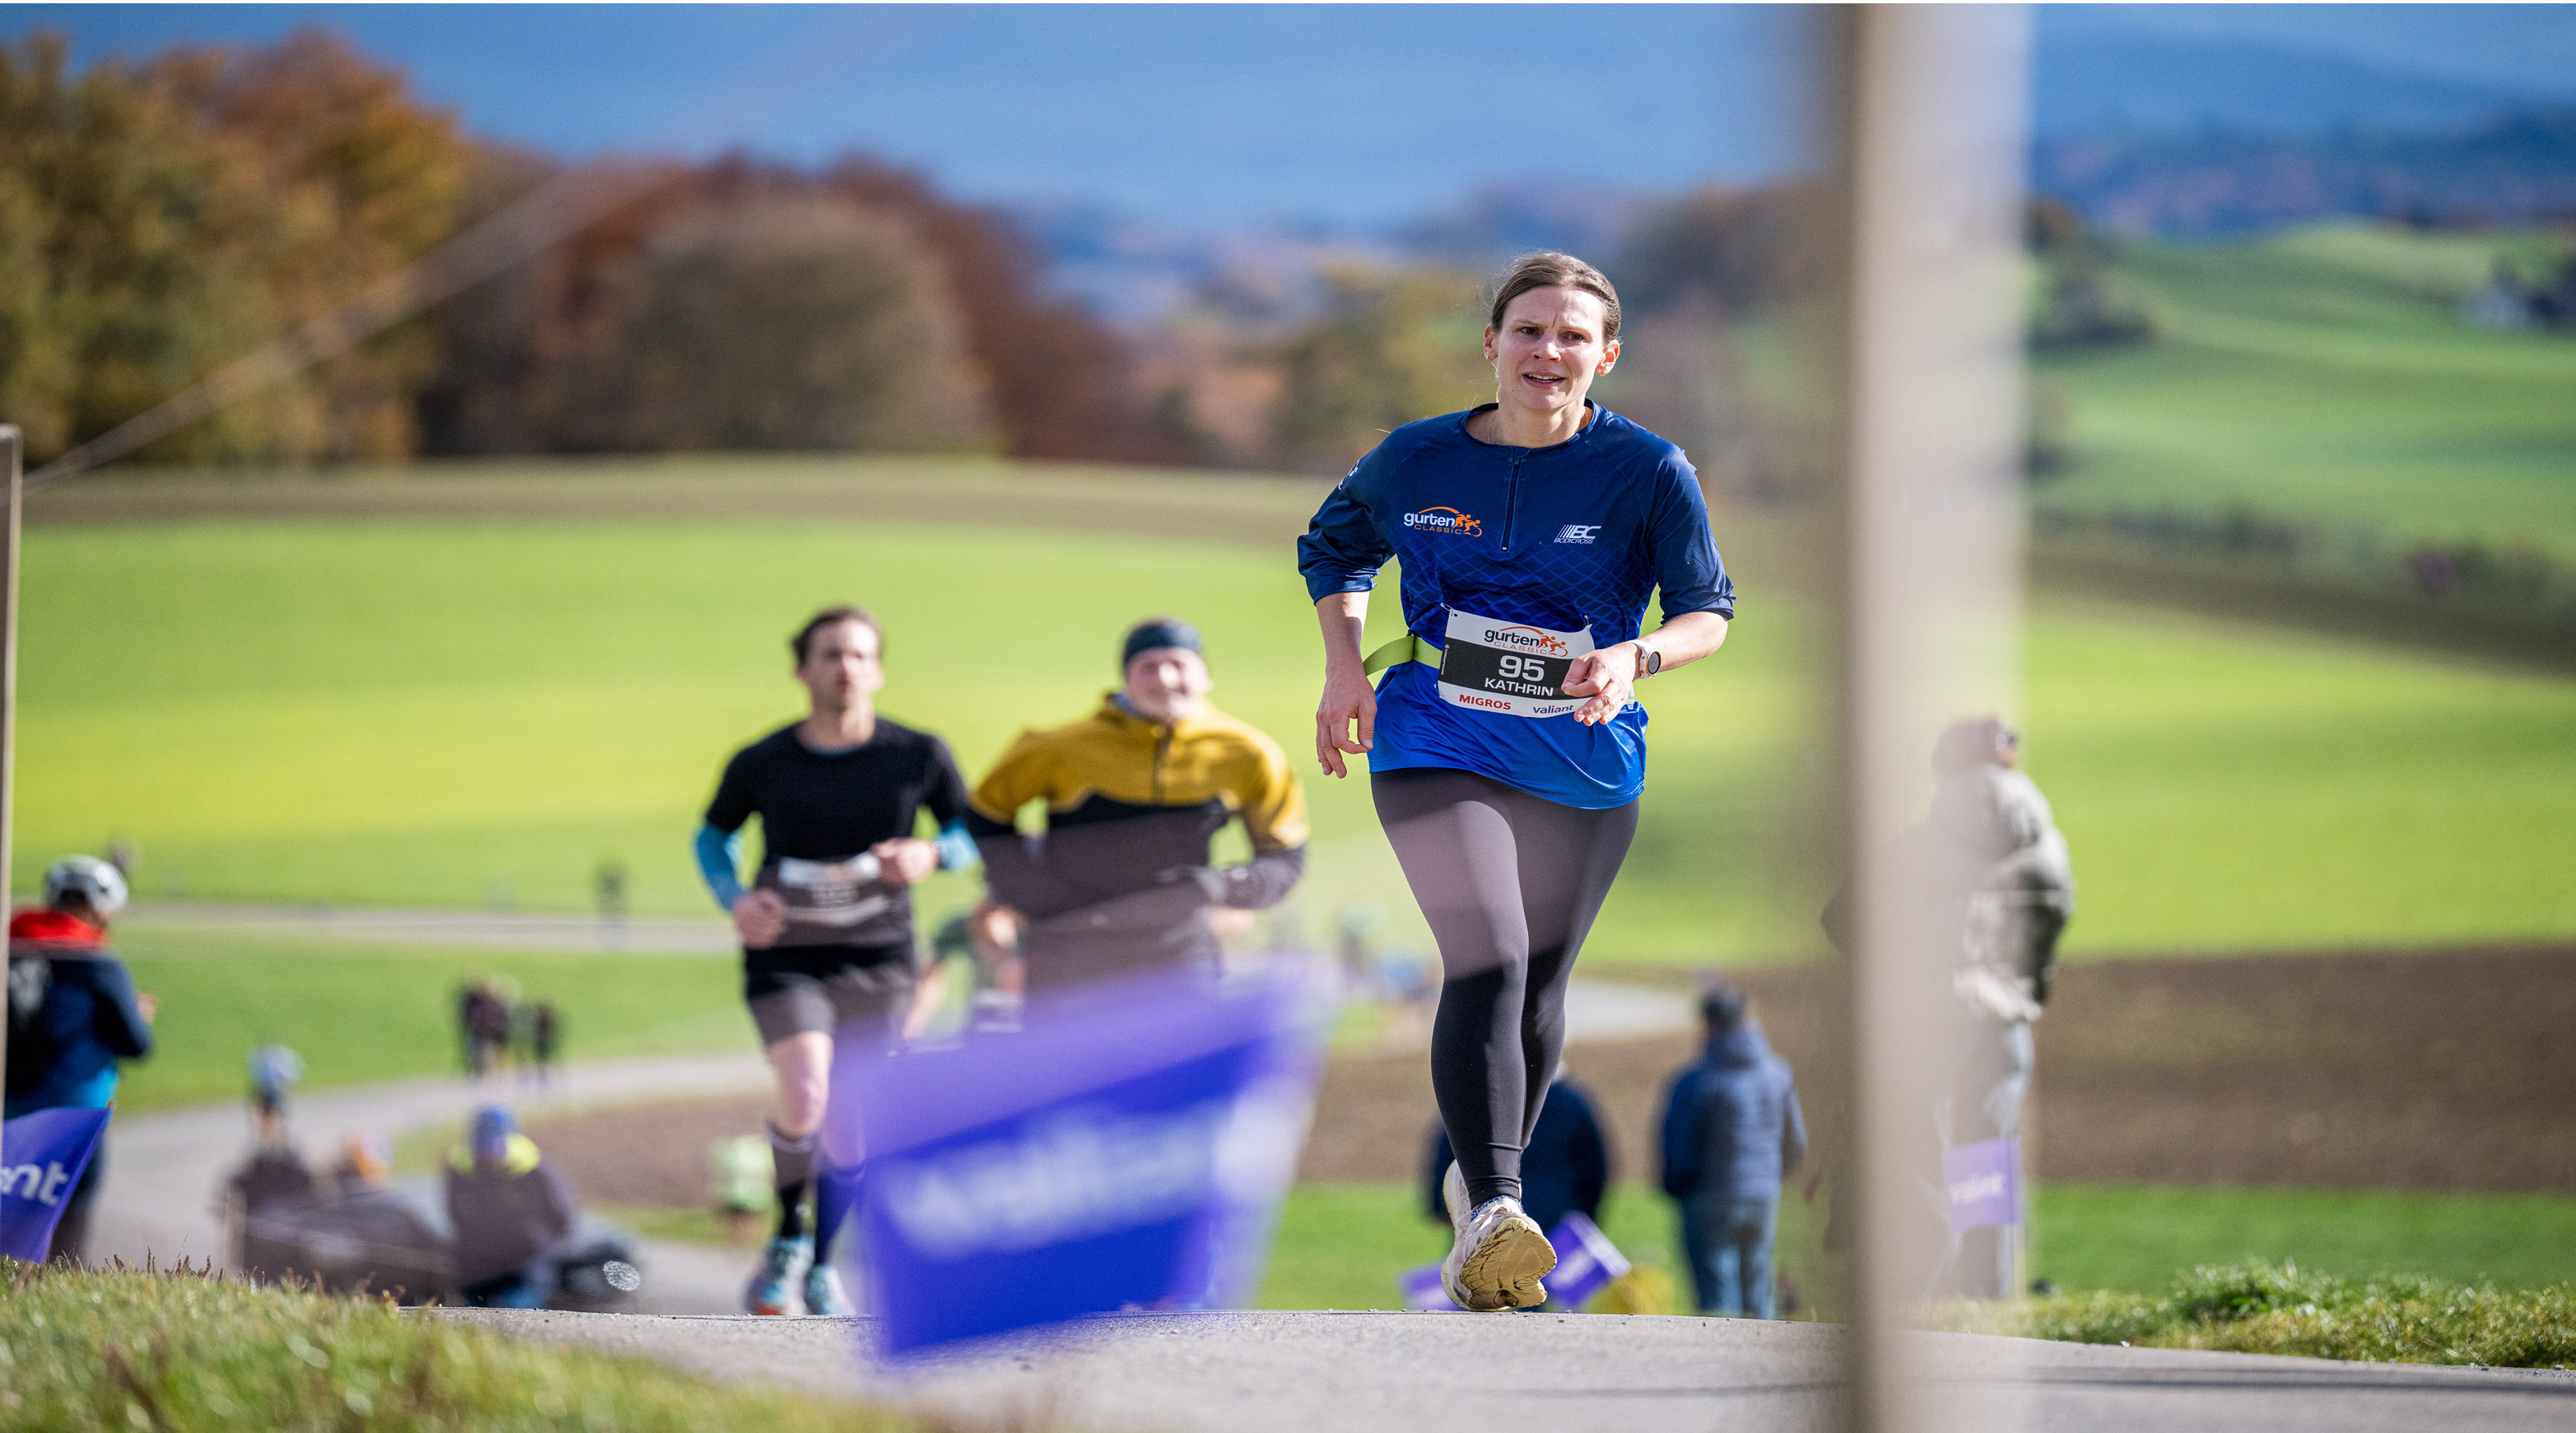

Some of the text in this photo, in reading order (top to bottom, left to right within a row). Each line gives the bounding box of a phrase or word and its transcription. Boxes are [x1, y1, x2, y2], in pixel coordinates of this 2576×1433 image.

[1403, 513, 1456, 527] gurten
[1414, 524, 1462, 535] CLASSIC
[1484, 630, 1540, 647] gurten
[1494, 641, 1547, 655] CLASSIC
[1498, 654, 1545, 682] 95
[1484, 677, 1554, 697] KATHRIN
[1459, 694, 1512, 710] MIGROS
[1532, 705, 1574, 714] valiant
